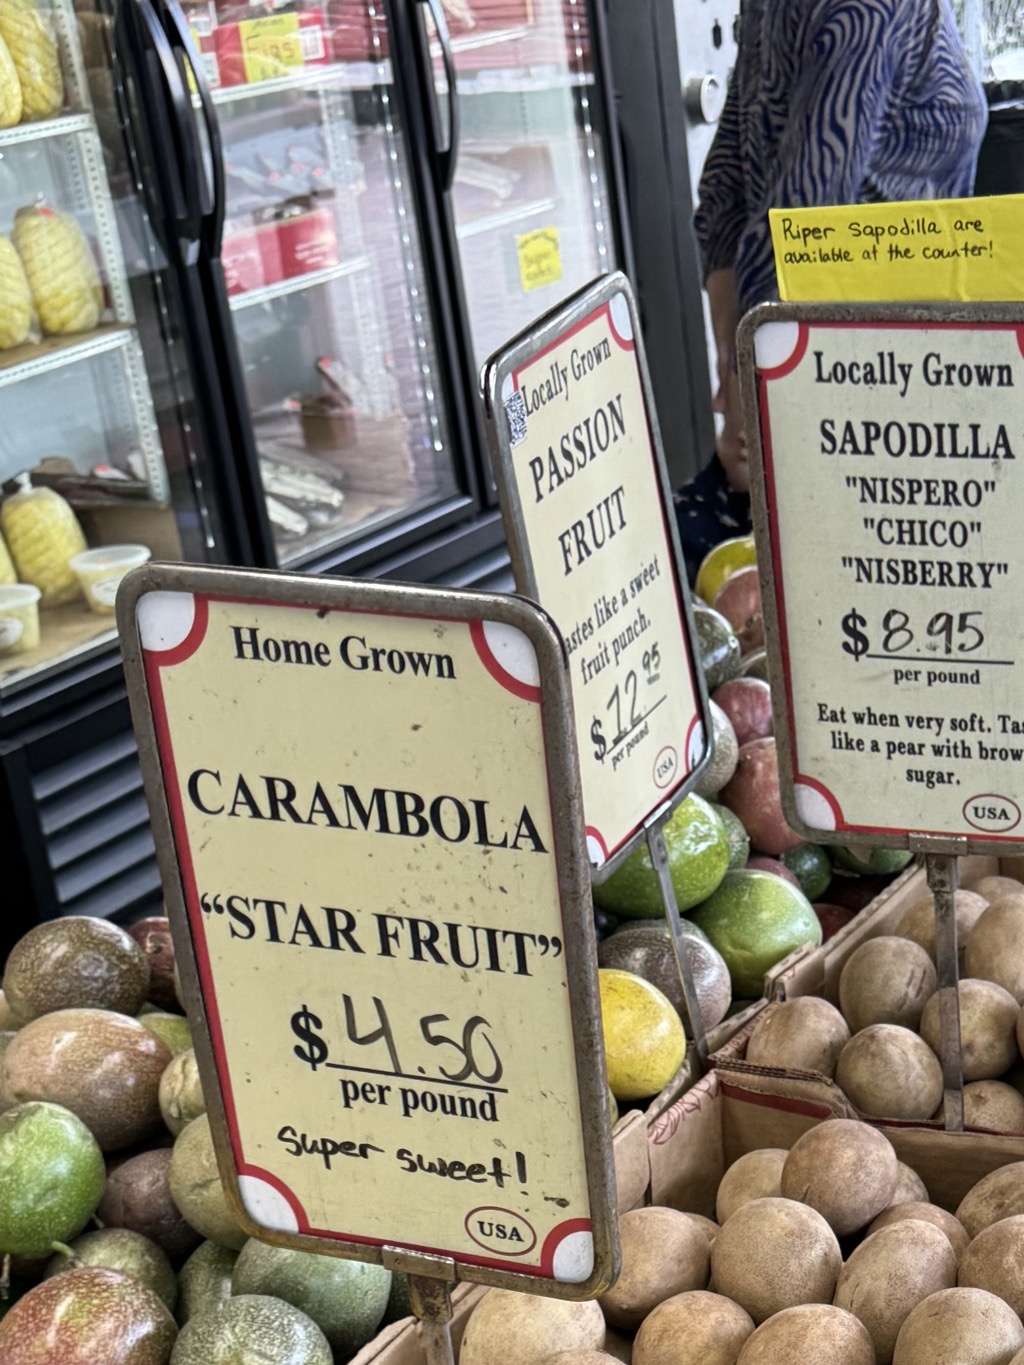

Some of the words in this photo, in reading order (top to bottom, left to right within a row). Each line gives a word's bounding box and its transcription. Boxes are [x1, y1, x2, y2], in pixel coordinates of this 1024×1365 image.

[781, 217, 835, 247] Riper
[953, 218, 984, 233] are
[783, 247, 854, 264] available
[861, 244, 878, 261] at
[887, 243, 915, 262] the
[922, 240, 993, 260] counter!
[520, 361, 570, 416] Locally
[570, 337, 612, 381] Grown
[813, 350, 913, 398] Locally
[922, 352, 1014, 387] Grown
[528, 394, 627, 504] PASSION
[819, 418, 1016, 460] SAPODILLA
[845, 475, 996, 508] "NISPERO"
[557, 486, 628, 577] FRUIT
[863, 517, 982, 549] "CHICO"
[841, 556, 1009, 588] "NISBERRY"
[565, 616, 594, 654] astes
[593, 594, 619, 629] like
[620, 587, 629, 607] a
[629, 552, 661, 599] sweet
[228, 624, 332, 667] Home
[339, 634, 457, 680] Grown
[580, 641, 611, 686] fruit
[611, 606, 652, 668] punch.
[893, 668, 921, 684] per
[927, 669, 981, 686] pound
[816, 703, 847, 724] Eat
[852, 706, 900, 728] when
[904, 714, 944, 736] very
[949, 713, 992, 734] soft.
[611, 747, 625, 772] per
[625, 720, 650, 758] pound
[830, 731, 865, 752] like
[870, 740, 881, 753] a
[885, 741, 926, 760] pear
[930, 738, 972, 759] with
[656, 756, 674, 779] USA
[906, 767, 961, 789] sugar.
[187, 768, 550, 855] CARAMBOLA
[971, 806, 1012, 821] USA
[290, 993, 503, 1084] $4.50
[338, 1078, 392, 1108] per
[399, 1087, 500, 1123] pound
[277, 1125, 386, 1170] Super
[476, 1220, 525, 1243] USA
